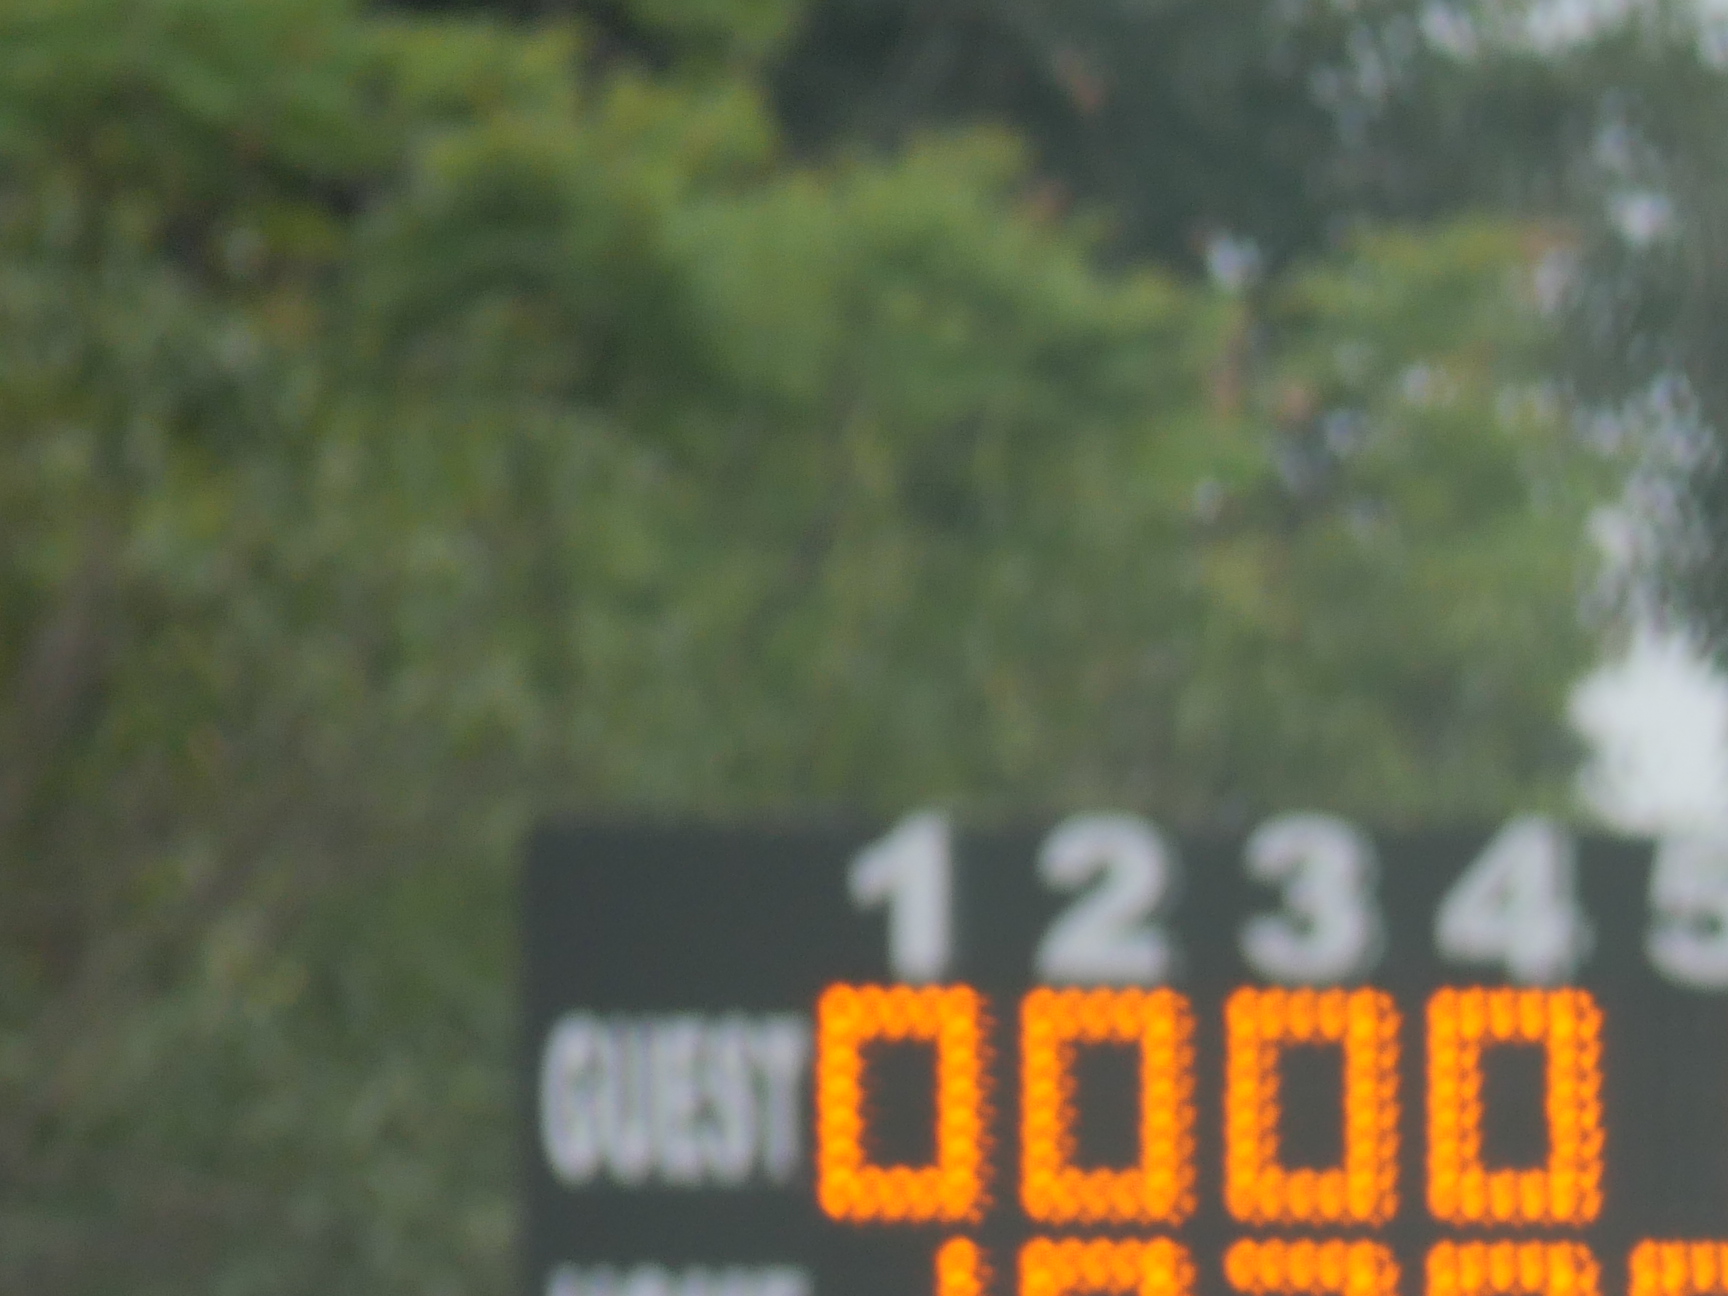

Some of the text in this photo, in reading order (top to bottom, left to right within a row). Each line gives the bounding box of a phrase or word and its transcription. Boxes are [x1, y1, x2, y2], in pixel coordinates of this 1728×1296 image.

[848, 811, 955, 983] 1
[1034, 811, 1171, 984] 2
[1241, 811, 1385, 988] 3
[1434, 812, 1590, 988] 4
[541, 1014, 810, 1186] GUEST
